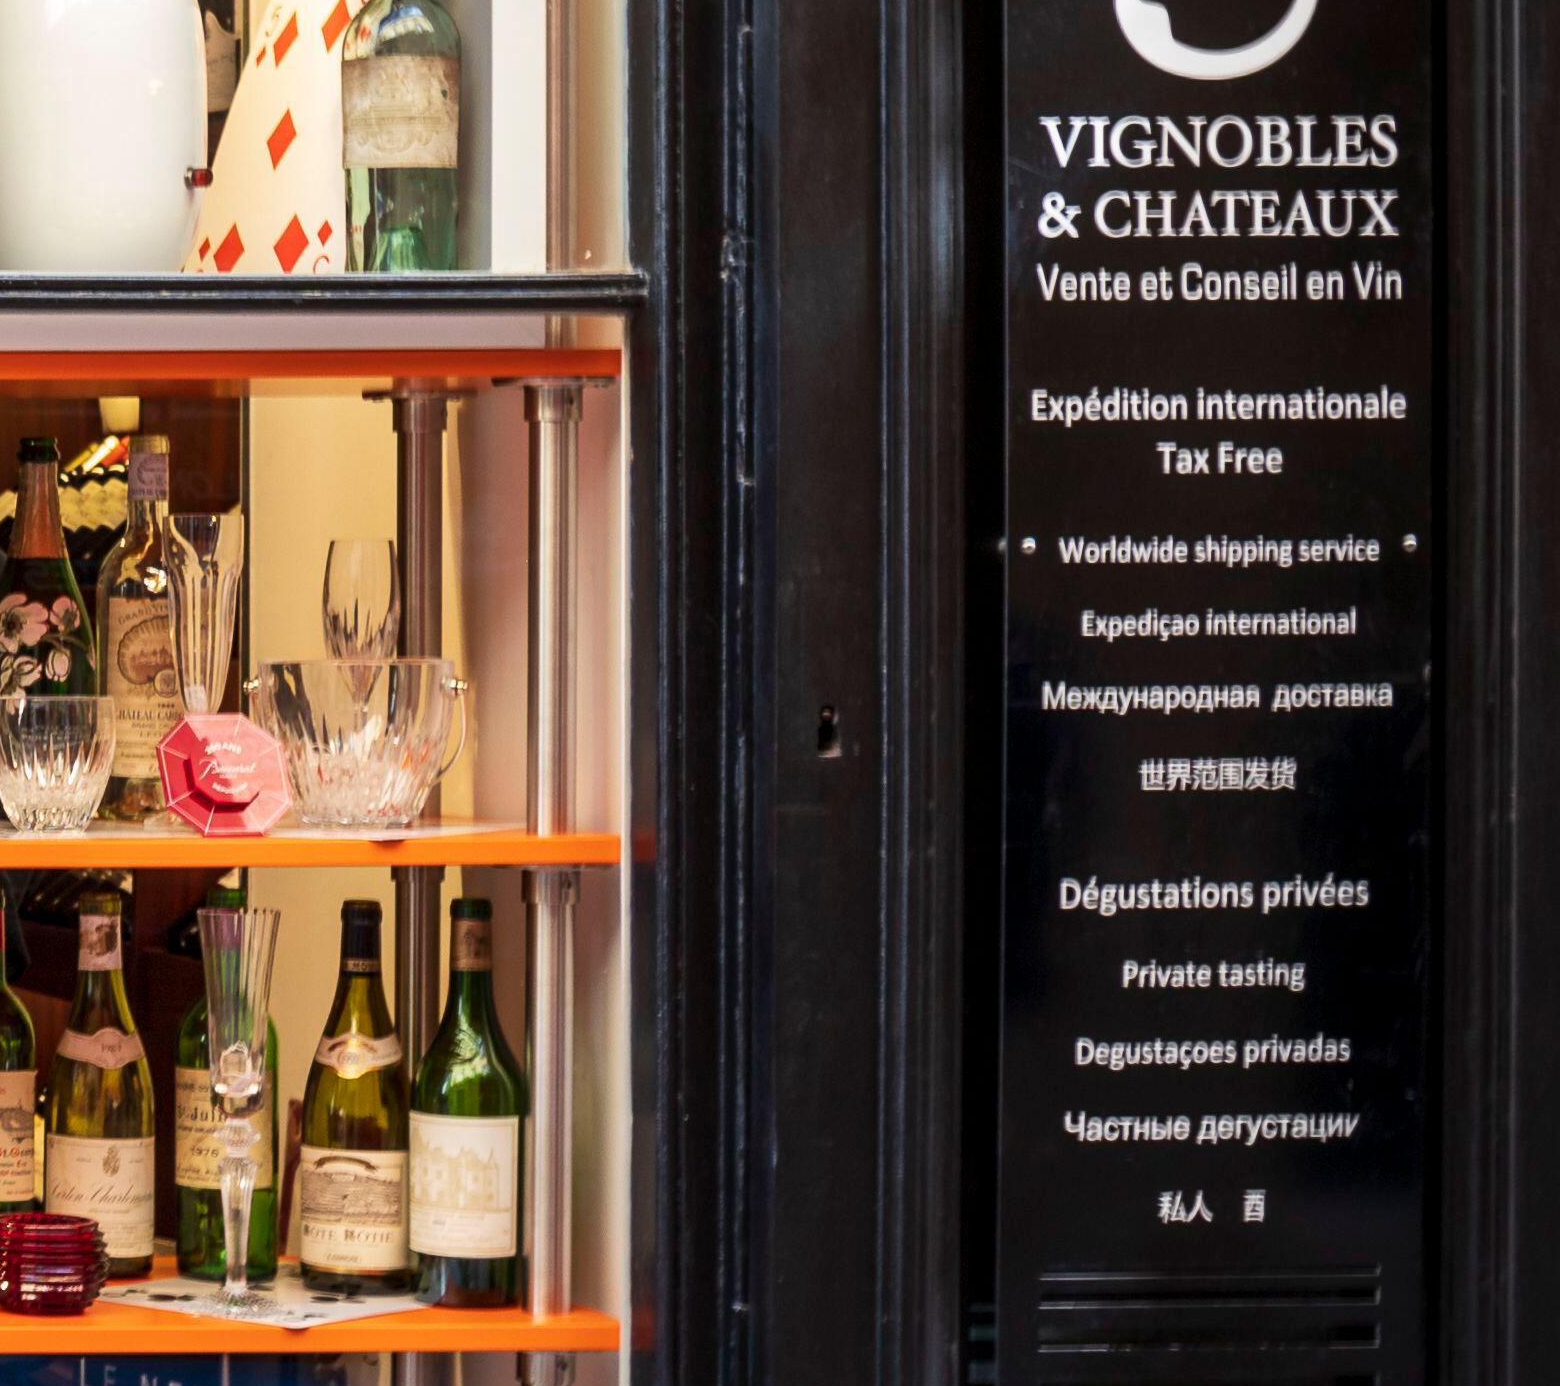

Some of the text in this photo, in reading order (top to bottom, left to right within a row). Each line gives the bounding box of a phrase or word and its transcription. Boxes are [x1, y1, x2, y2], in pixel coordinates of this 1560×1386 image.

[1039, 114, 1398, 169] VIGNOBLES
[1037, 189, 1400, 239] & CHATEAUX
[1036, 261, 1402, 302] Vente et Conseil en Vin
[1031, 385, 1407, 428] Expédition internationale
[1156, 441, 1283, 475] Tax Free
[1058, 533, 1380, 568] Worldwide shipping service
[1081, 606, 1357, 643] Expediçao international
[1042, 681, 1393, 716] Международная доставка
[1139, 757, 1297, 791] 世界范围发货
[1059, 872, 1369, 917] Dégustations privées
[1122, 957, 1305, 992] Private tasting
[1075, 1033, 1351, 1071] Degustaçoes privadas
[1064, 1111, 1191, 1142] Частные
